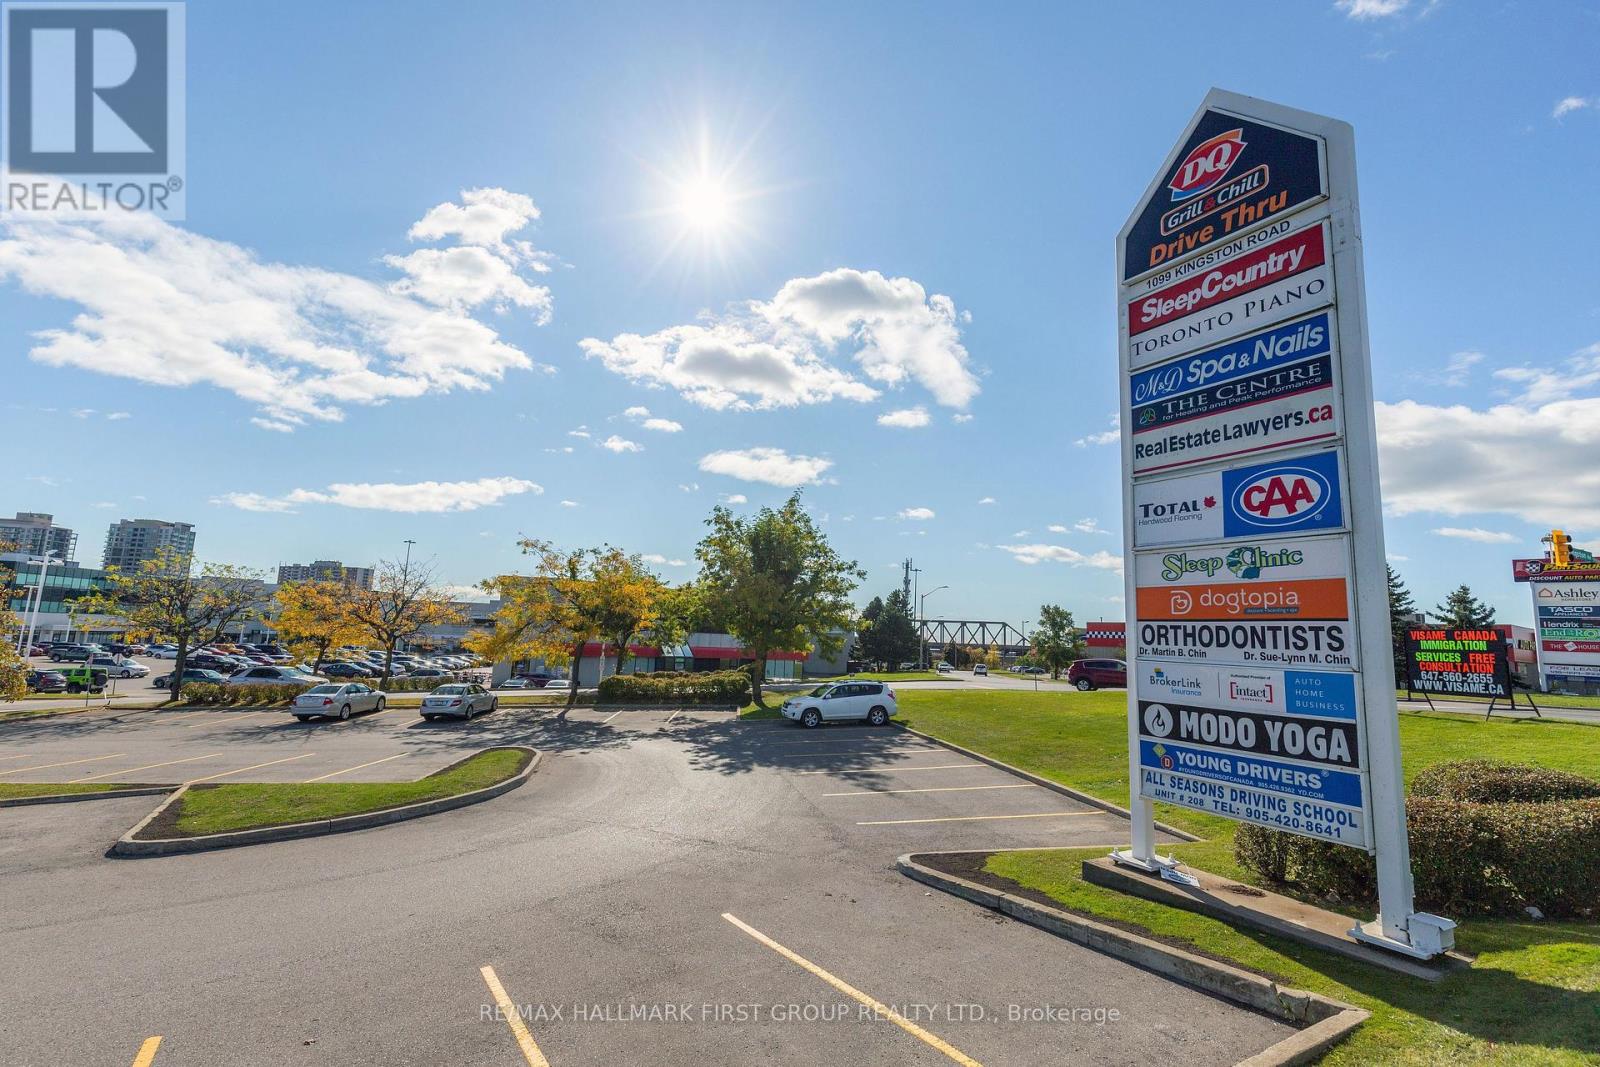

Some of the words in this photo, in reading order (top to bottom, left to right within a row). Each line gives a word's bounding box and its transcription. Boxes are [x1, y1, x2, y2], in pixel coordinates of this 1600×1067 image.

[1181, 142, 1233, 188] DQ
[1150, 224, 1214, 267] Drive
[1221, 189, 1288, 232] Thru
[1146, 273, 1171, 289] 1099
[1175, 242, 1242, 277] KINGSTON
[1248, 220, 1290, 246] ROAD
[1131, 311, 1233, 356] TORONTO
[1245, 279, 1325, 318] PIANO
[1188, 352, 1236, 384] Spa
[1238, 354, 1250, 368] &
[1252, 324, 1324, 364] Nails
[1162, 392, 1208, 414] THE
[1215, 362, 1322, 399] CENTRE
[1162, 412, 1174, 421] for
[1175, 404, 1207, 420] Healing
[1209, 400, 1227, 411] and
[1228, 394, 1252, 407] Peak
[1254, 377, 1322, 398] Performance
[1243, 476, 1315, 517] CAA
[1139, 500, 1200, 518] TOTAL
[1138, 516, 1173, 526] Hardwood
[1173, 513, 1203, 524] Flooring
[1162, 553, 1223, 582] Sleep
[1200, 587, 1299, 614] dogtopia
[1554, 588, 1598, 600] Ashley
[1141, 623, 1345, 652] ORTHODONTISTS
[1410, 630, 1446, 641] VISAME
[1454, 630, 1497, 641] CANADA
[1545, 628, 1566, 637] End
[1139, 647, 1150, 656] Dr.
[1152, 648, 1176, 657] Martin
[1178, 649, 1186, 657] B.
[1188, 649, 1207, 659] Chin
[1420, 640, 1487, 651] IMMIGRATION
[1244, 651, 1258, 661] Dr.
[1260, 652, 1306, 664] Sue-Lynn
[1309, 654, 1321, 664] M.
[1325, 654, 1350, 665] Chin
[1415, 652, 1461, 663] SERVICES
[1469, 653, 1495, 664] FREE
[1419, 661, 1494, 673] CONSULTATION
[1150, 675, 1201, 689] BrokerLink
[1295, 678, 1321, 687] AUTO
[1421, 671, 1493, 684] 647-560-2655
[1171, 687, 1202, 697] Insurance
[1295, 689, 1324, 698] HOME
[1413, 679, 1504, 695] WWW.VISAME.CA
[1296, 700, 1345, 711] BUSINESS
[1179, 710, 1256, 749] MODO
[1263, 720, 1352, 763] YOGA
[1176, 751, 1232, 773] YOUNG
[1237, 762, 1322, 789] DRIVERS
[1145, 771, 1164, 786] ALL
[1169, 775, 1225, 800] SEASONS
[1230, 787, 1287, 812] DRIVING
[1293, 801, 1358, 828] SCHOOL
[1155, 788, 1176, 800] UNIT
[1188, 796, 1204, 807] 208
[1213, 799, 1240, 815] TEL:
[1246, 807, 1342, 838] 905-420-8641
